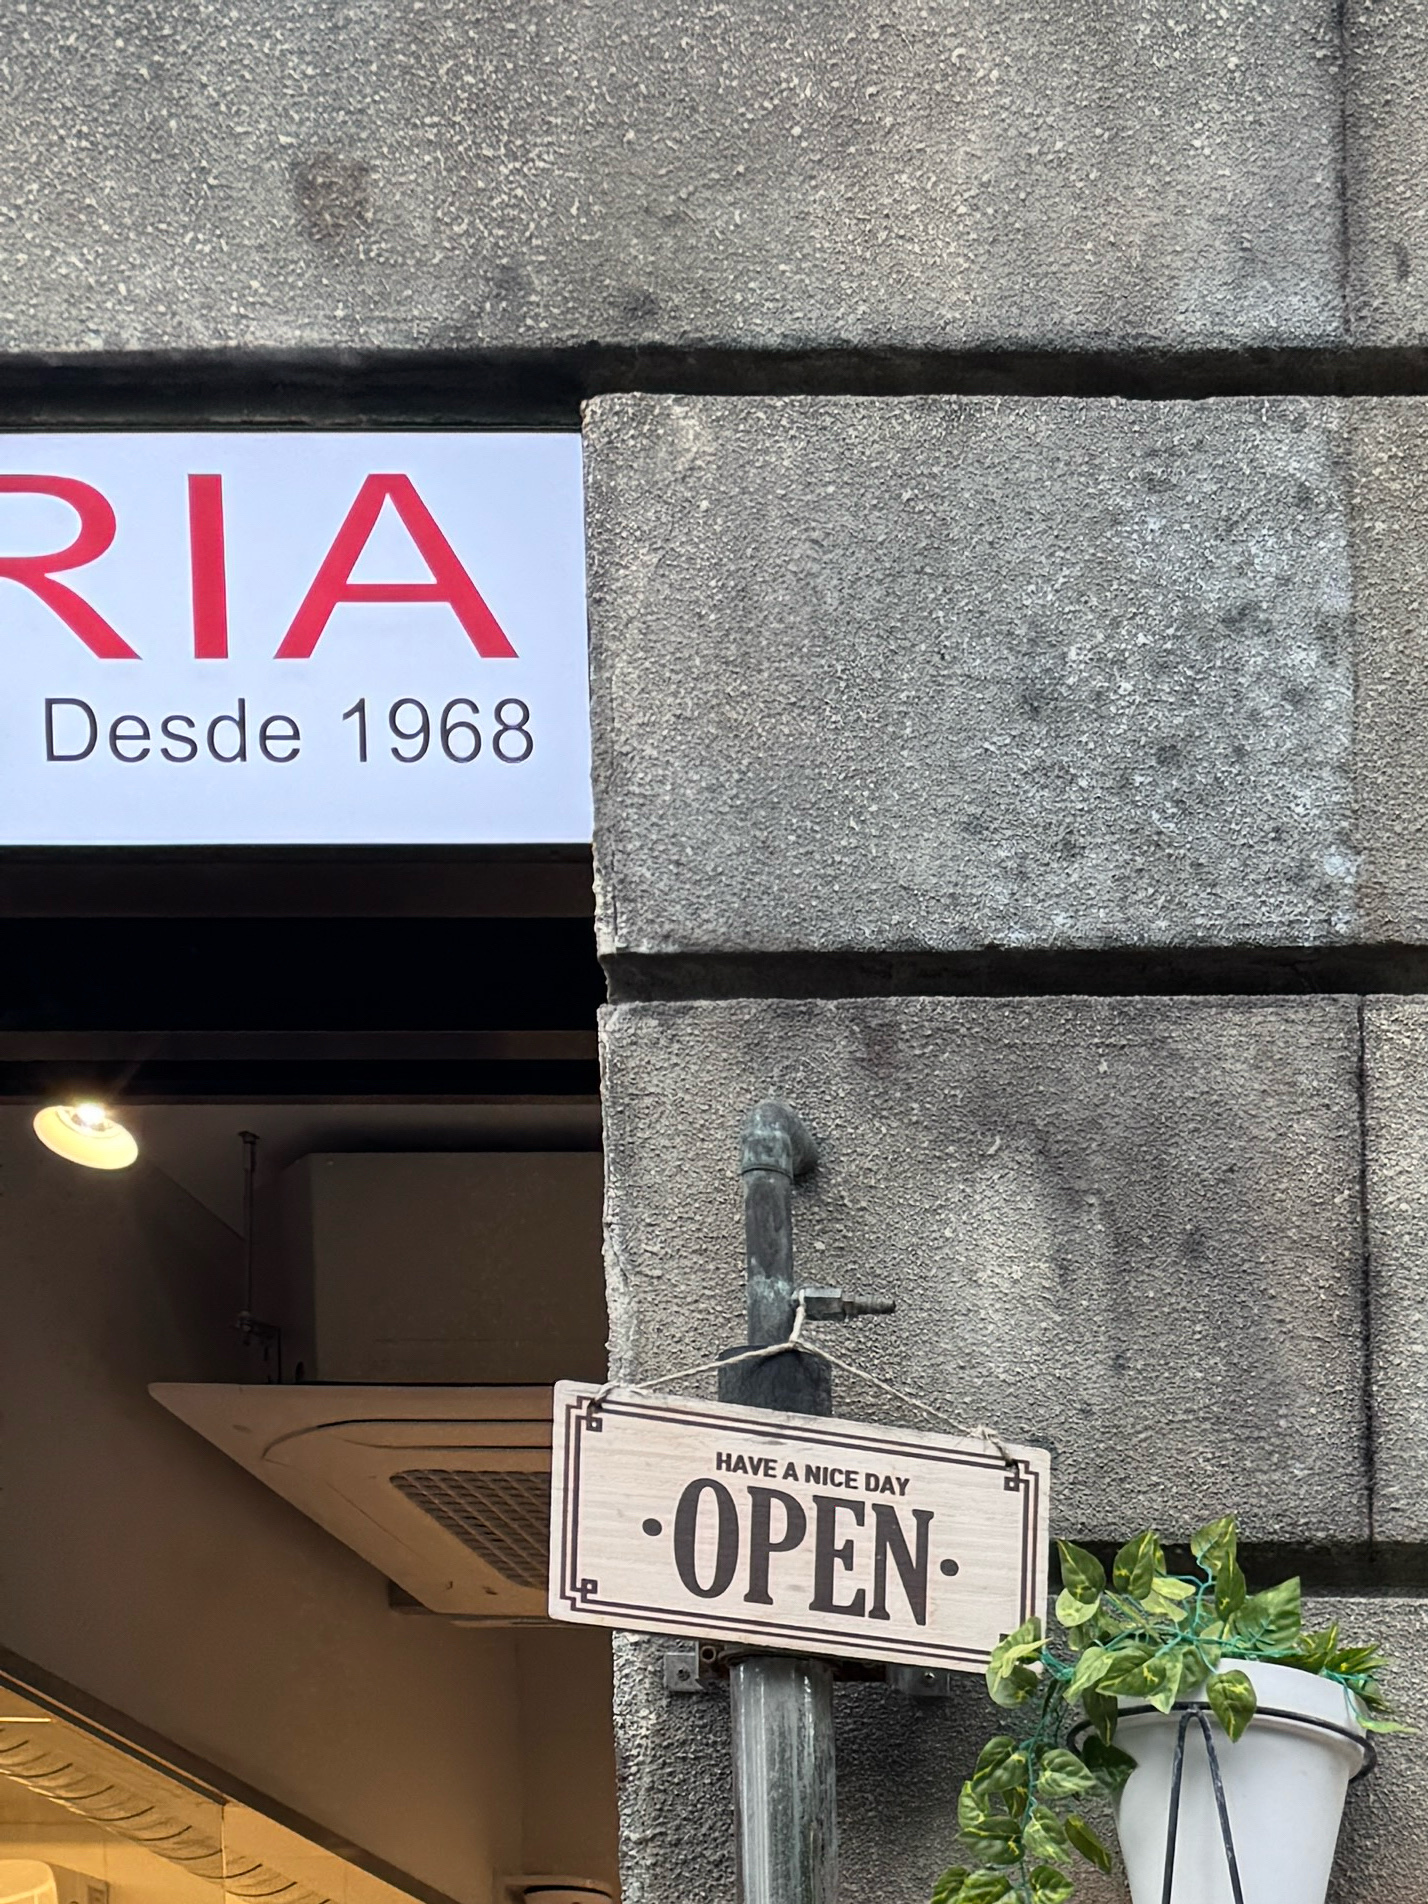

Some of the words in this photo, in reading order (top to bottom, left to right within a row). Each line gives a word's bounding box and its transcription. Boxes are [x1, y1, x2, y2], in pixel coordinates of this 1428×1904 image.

[0, 473, 520, 660] RIA
[44, 697, 301, 763] Desde
[342, 697, 534, 763] 1968
[716, 1451, 778, 1479] HAVE
[782, 1461, 799, 1482] A
[805, 1464, 859, 1490] NICE
[865, 1472, 910, 1496] DAY
[673, 1477, 935, 1626] OPEN
